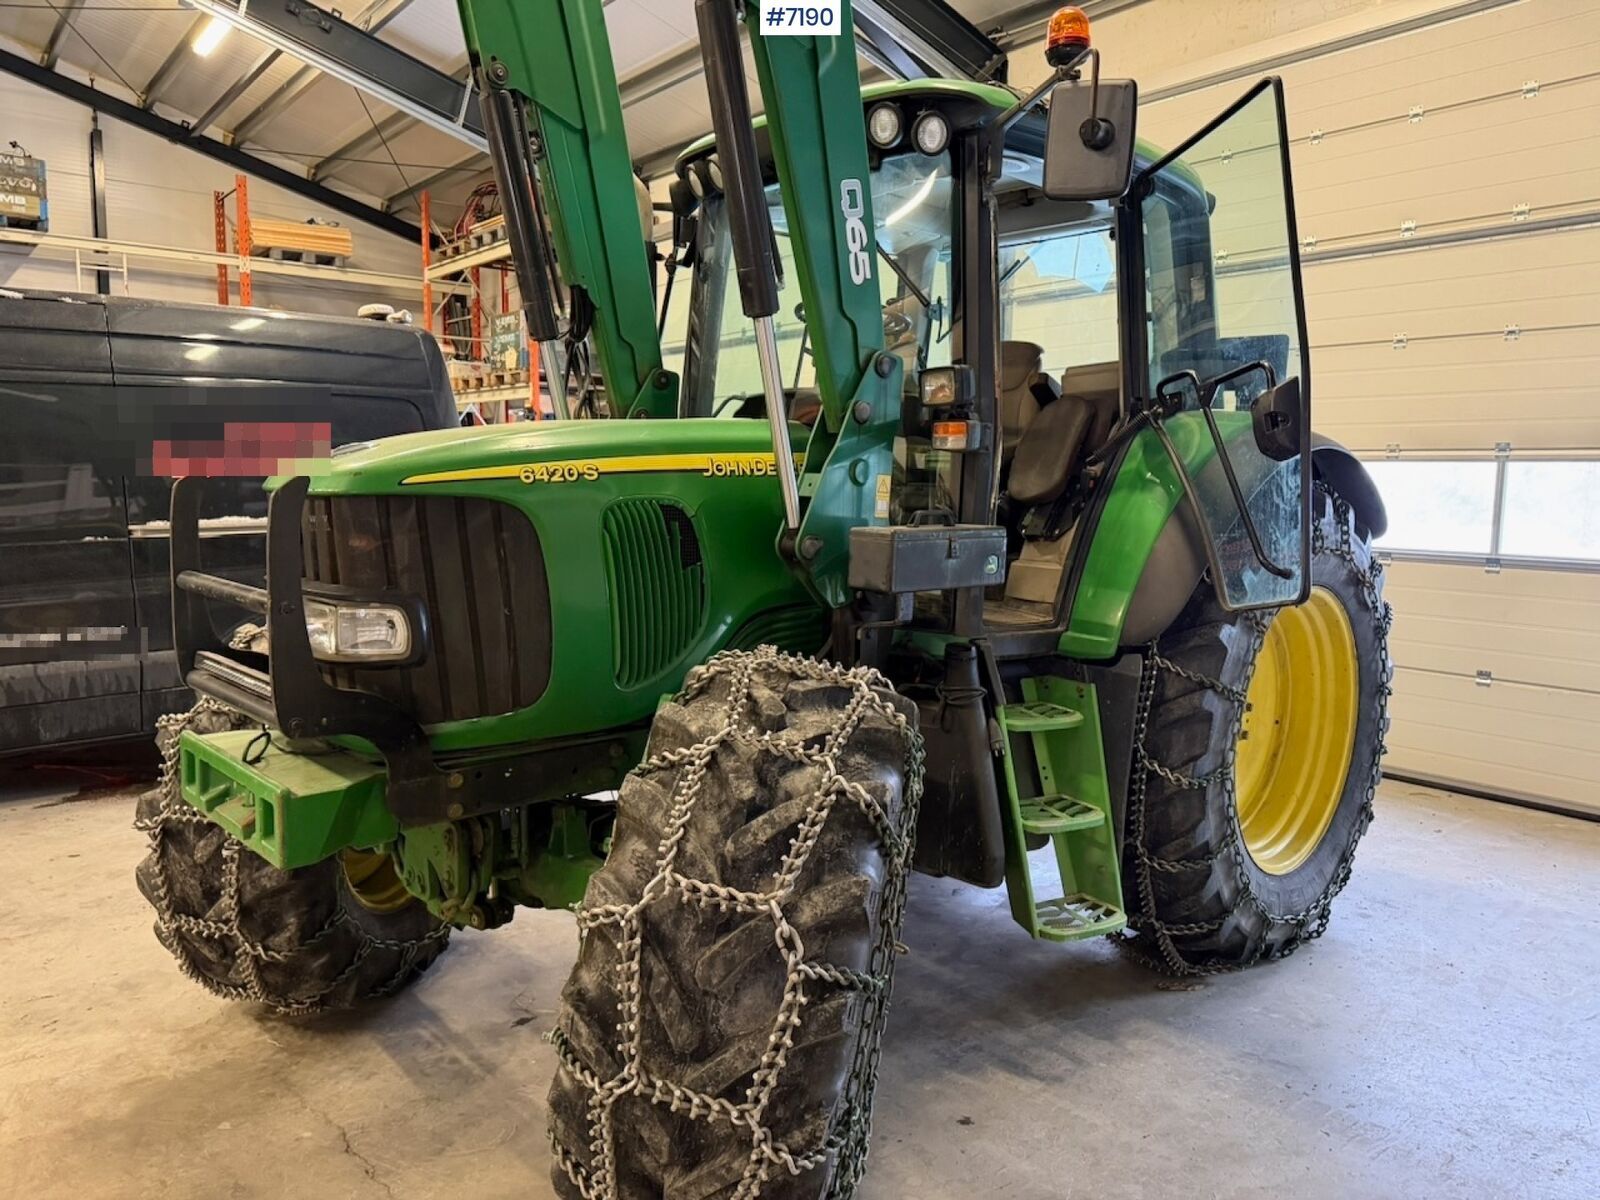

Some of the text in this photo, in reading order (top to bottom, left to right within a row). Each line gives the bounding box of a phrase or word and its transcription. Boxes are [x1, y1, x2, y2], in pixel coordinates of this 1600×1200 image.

[840, 179, 871, 285] Q65
[519, 464, 599, 484] 6420 S
